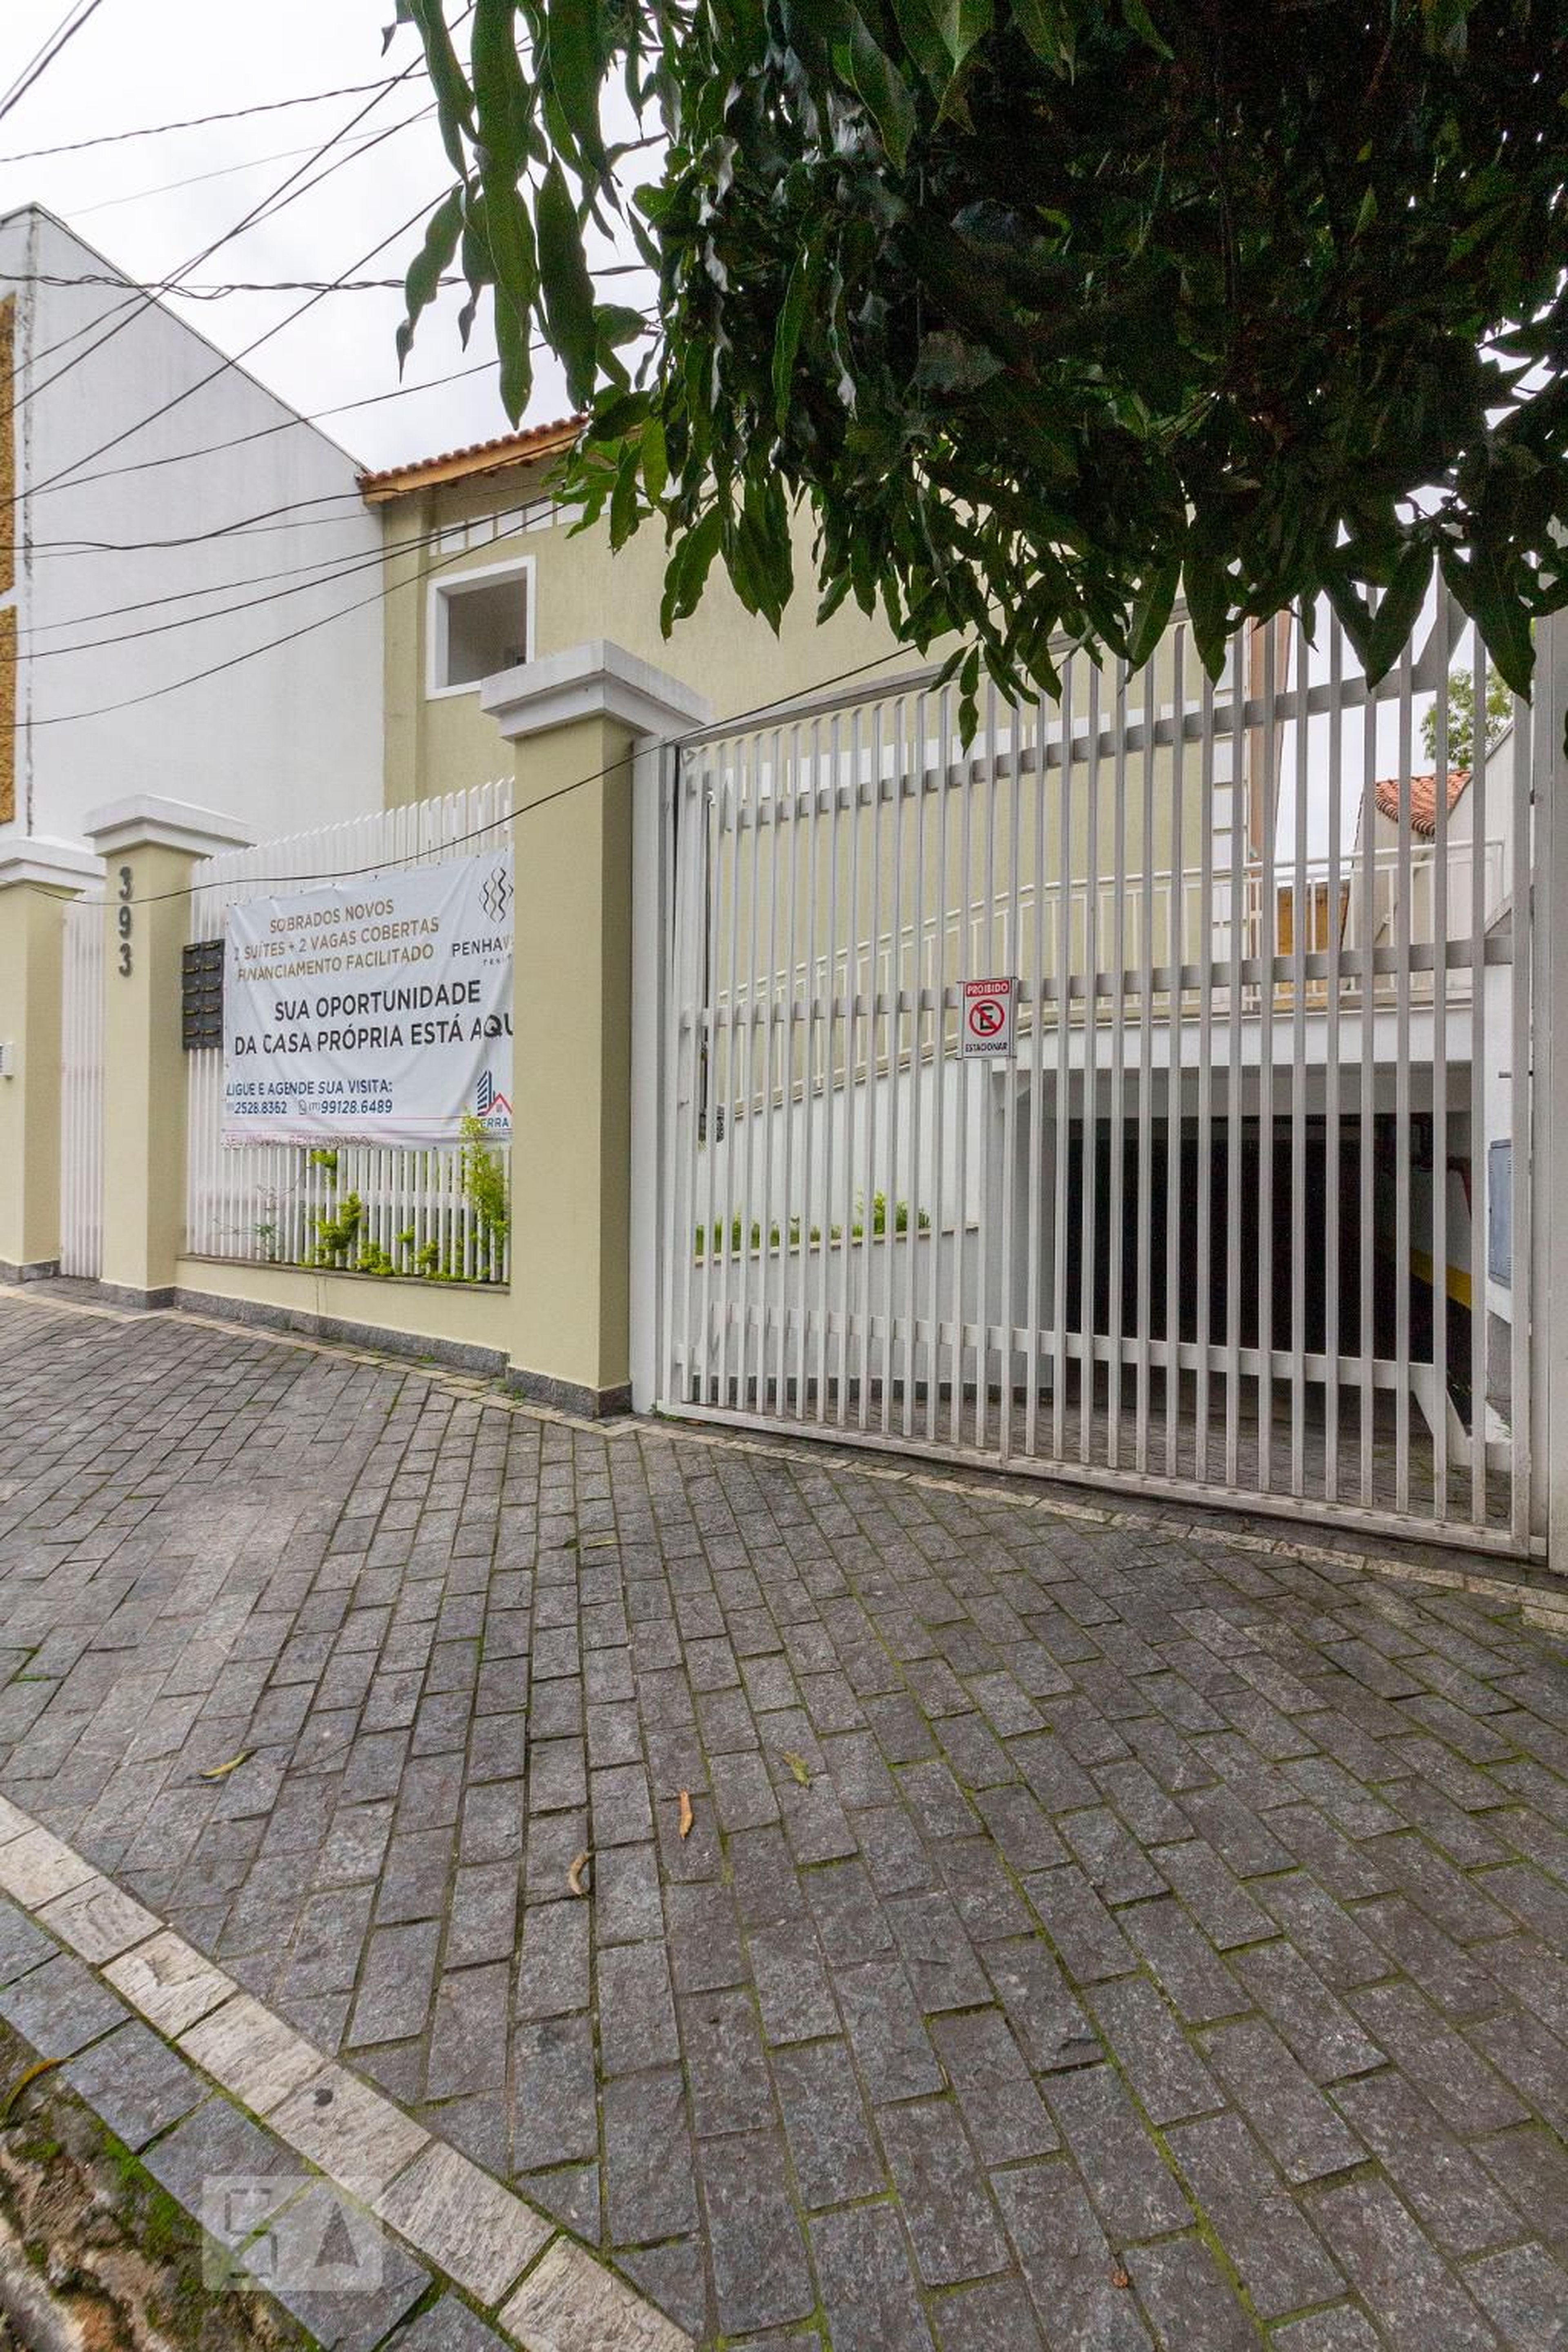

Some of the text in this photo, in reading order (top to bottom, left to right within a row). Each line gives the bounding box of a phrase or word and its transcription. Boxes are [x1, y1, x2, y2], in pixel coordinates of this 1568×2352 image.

[118, 866, 132, 977] 393
[270, 899, 394, 933] SOBRADOS NOVOS
[244, 940, 285, 960] SUÍTES
[298, 938, 307, 953] 2
[310, 931, 356, 950] VAGAS
[361, 917, 439, 943] COBERTAS
[238, 943, 434, 981] FINANCIAMENTO FACILITADO
[275, 980, 481, 1021] SUA OPORTUNIDADE
[967, 983, 1009, 995] PROIBIDO
[235, 1036, 257, 1055] DA
[263, 1032, 312, 1054] CASA
[318, 1024, 403, 1052] PRÓPRIA
[411, 1013, 463, 1045] ESTÁ
[965, 1042, 1008, 1052] ESTACIONAR
[226, 1079, 393, 1096] LIGUE E AGENDE SUA VISITA:
[321, 1099, 392, 1114] 99128.6489
